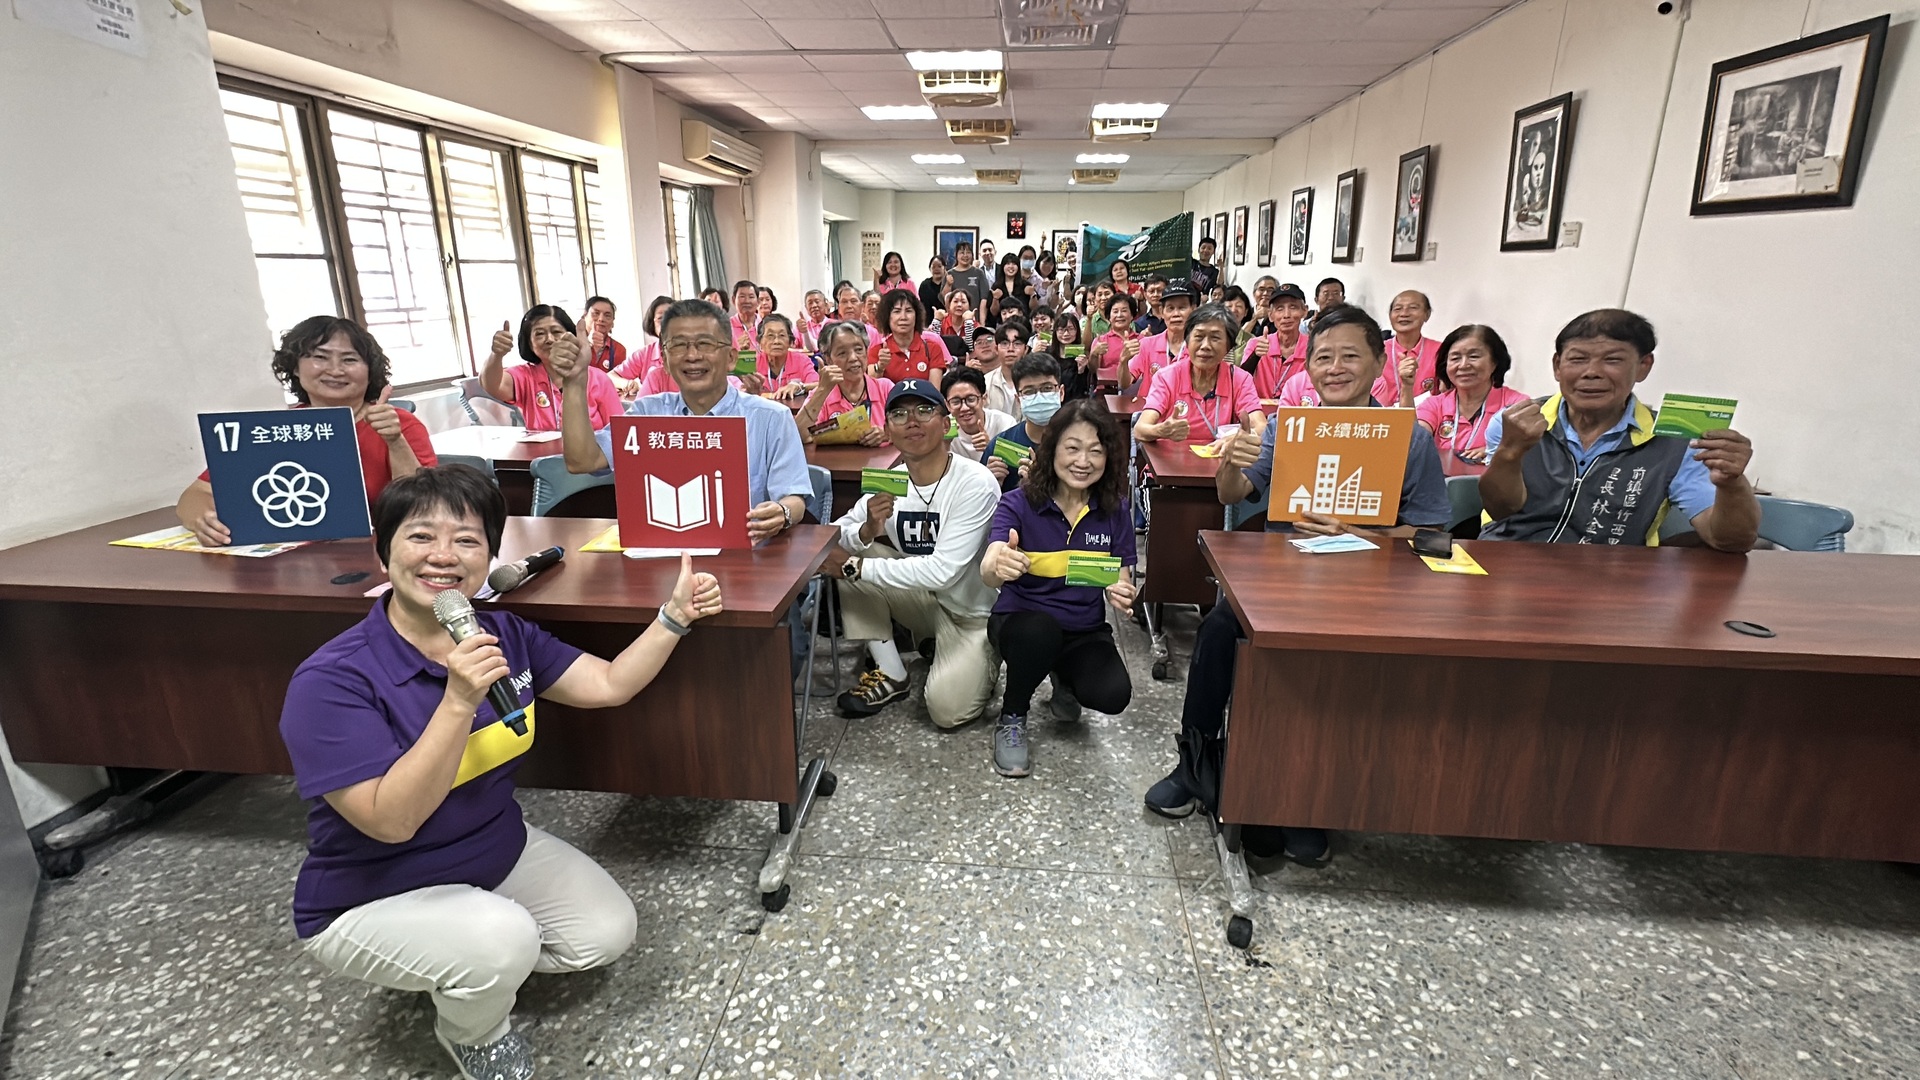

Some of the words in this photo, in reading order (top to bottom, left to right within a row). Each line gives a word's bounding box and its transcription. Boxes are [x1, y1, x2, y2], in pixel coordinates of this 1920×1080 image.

[213, 421, 240, 452] 17
[250, 422, 335, 444] 全球夥伴
[624, 425, 640, 455] 4
[648, 431, 723, 450] 教育品質
[1285, 416, 1306, 443] 11
[1314, 422, 1390, 439] 永續城市
